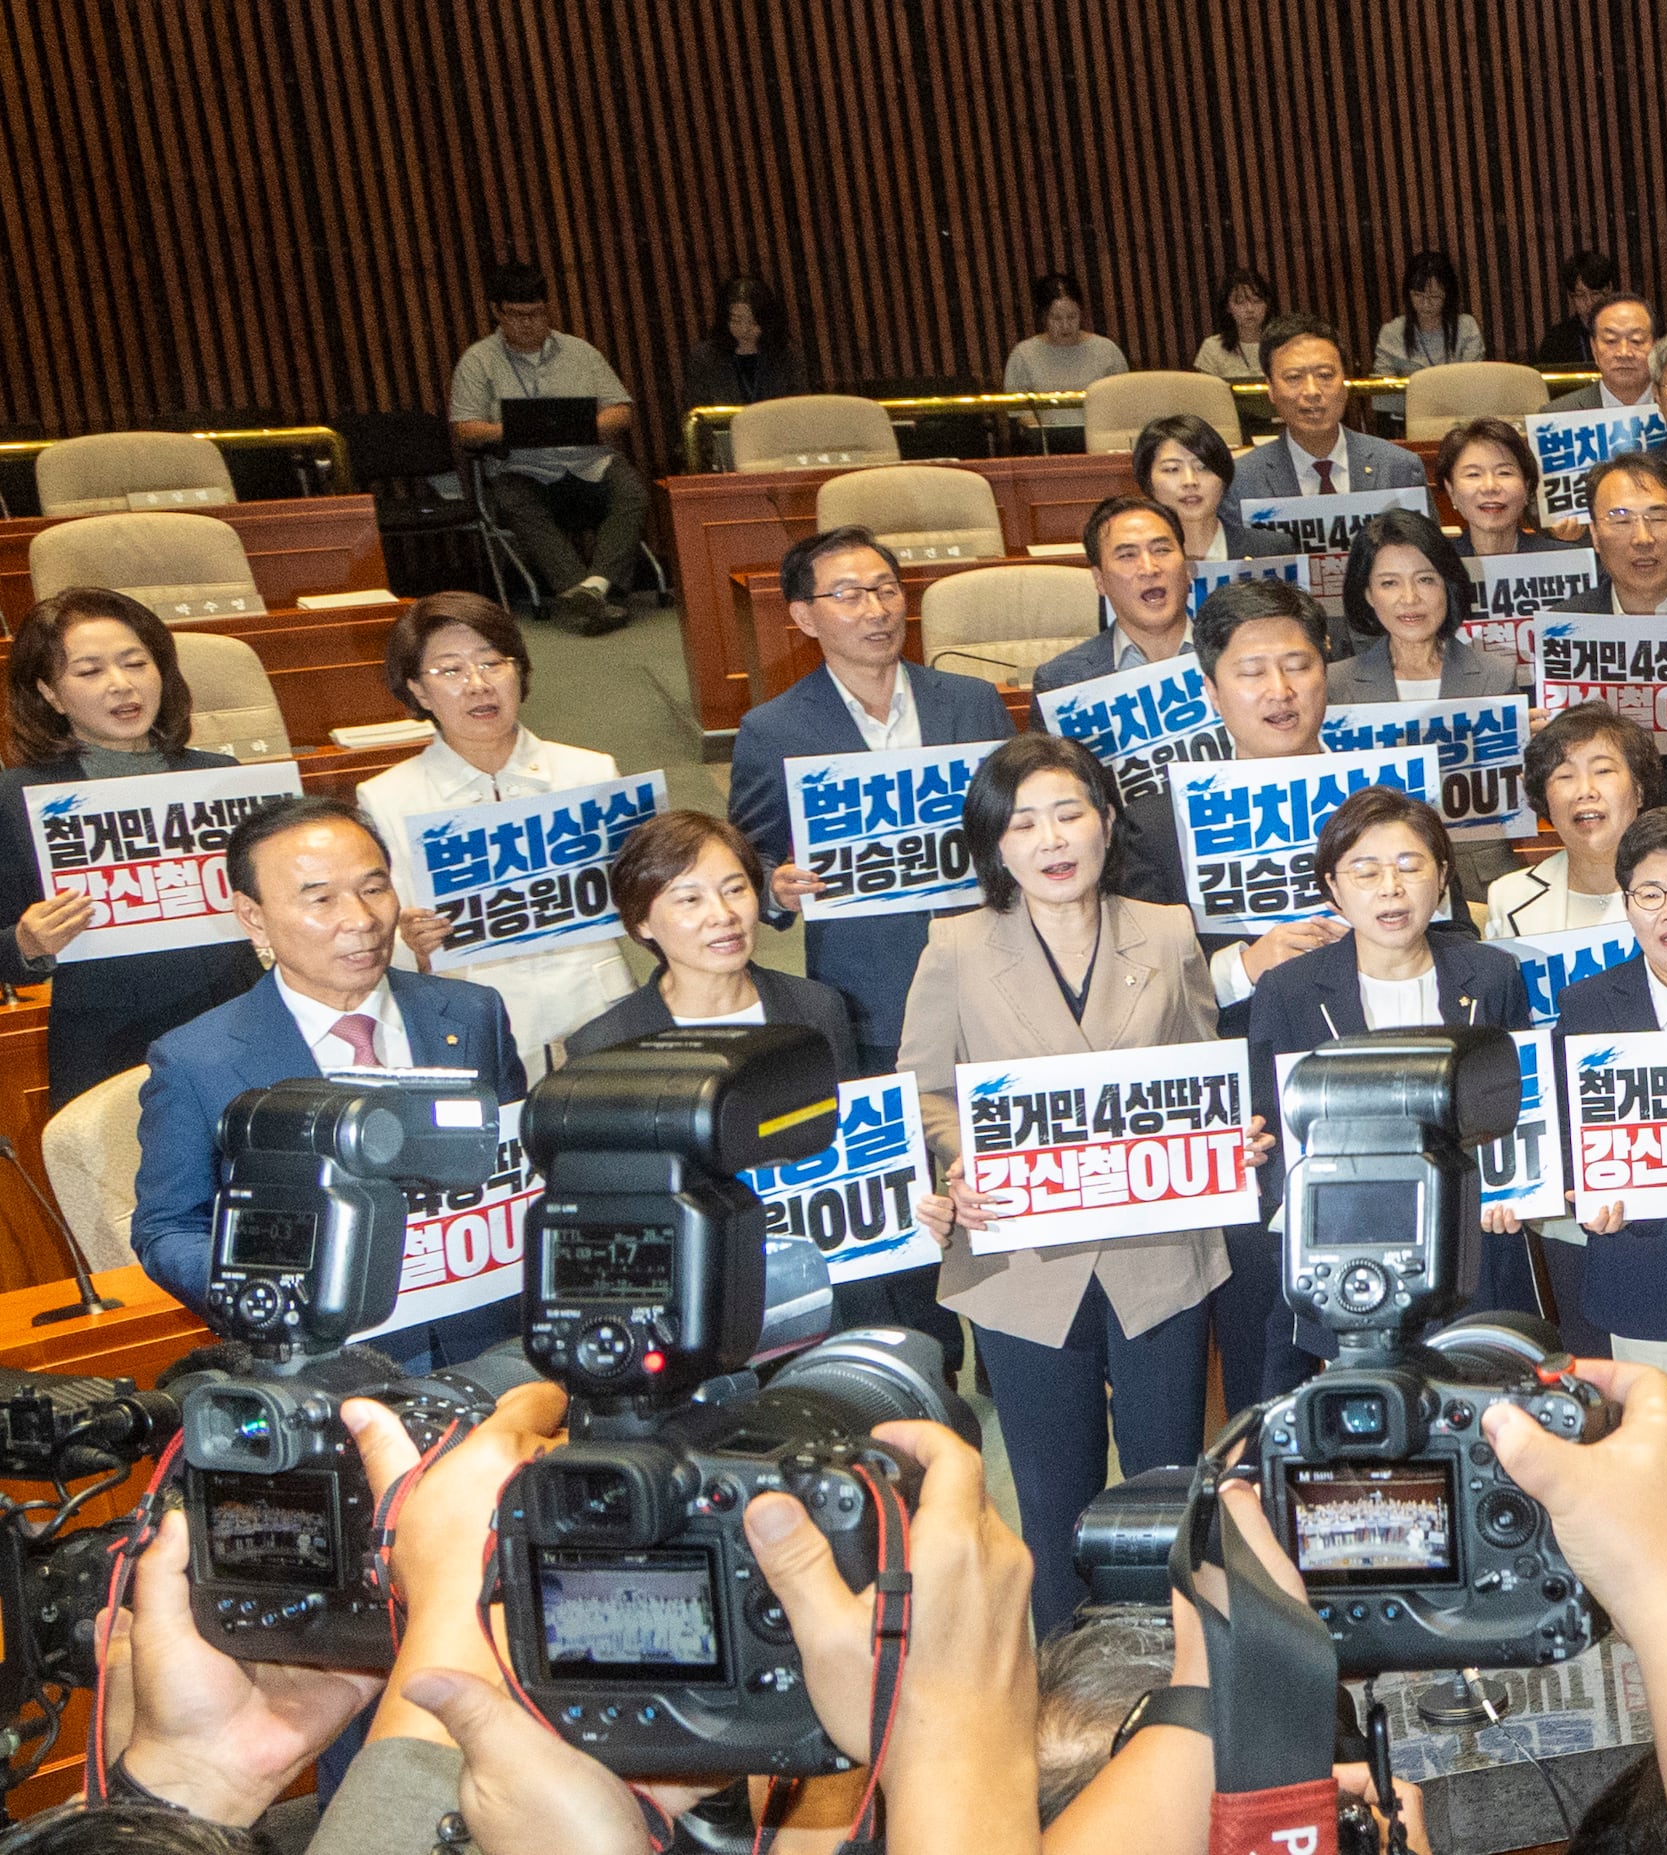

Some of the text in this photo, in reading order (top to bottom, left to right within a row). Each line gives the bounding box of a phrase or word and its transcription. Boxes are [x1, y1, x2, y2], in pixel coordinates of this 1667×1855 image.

[1542, 639, 1626, 681] 철거민
[1059, 667, 1208, 757] 법치상
[803, 763, 975, 843] 법치상
[1442, 765, 1521, 818] OUT
[43, 808, 161, 868] 철거민
[427, 783, 656, 897] 법치상실
[809, 833, 974, 898] 김승원O
[54, 858, 235, 930] 강신철O
[437, 875, 612, 950] 김승원O
[1199, 846, 1322, 916] 김승원
[971, 1073, 1240, 1152] 철거민 4성딱지
[767, 1166, 916, 1252] OUT
[975, 1134, 1243, 1217] 강신철OUT
[405, 1198, 524, 1284] 철OU
